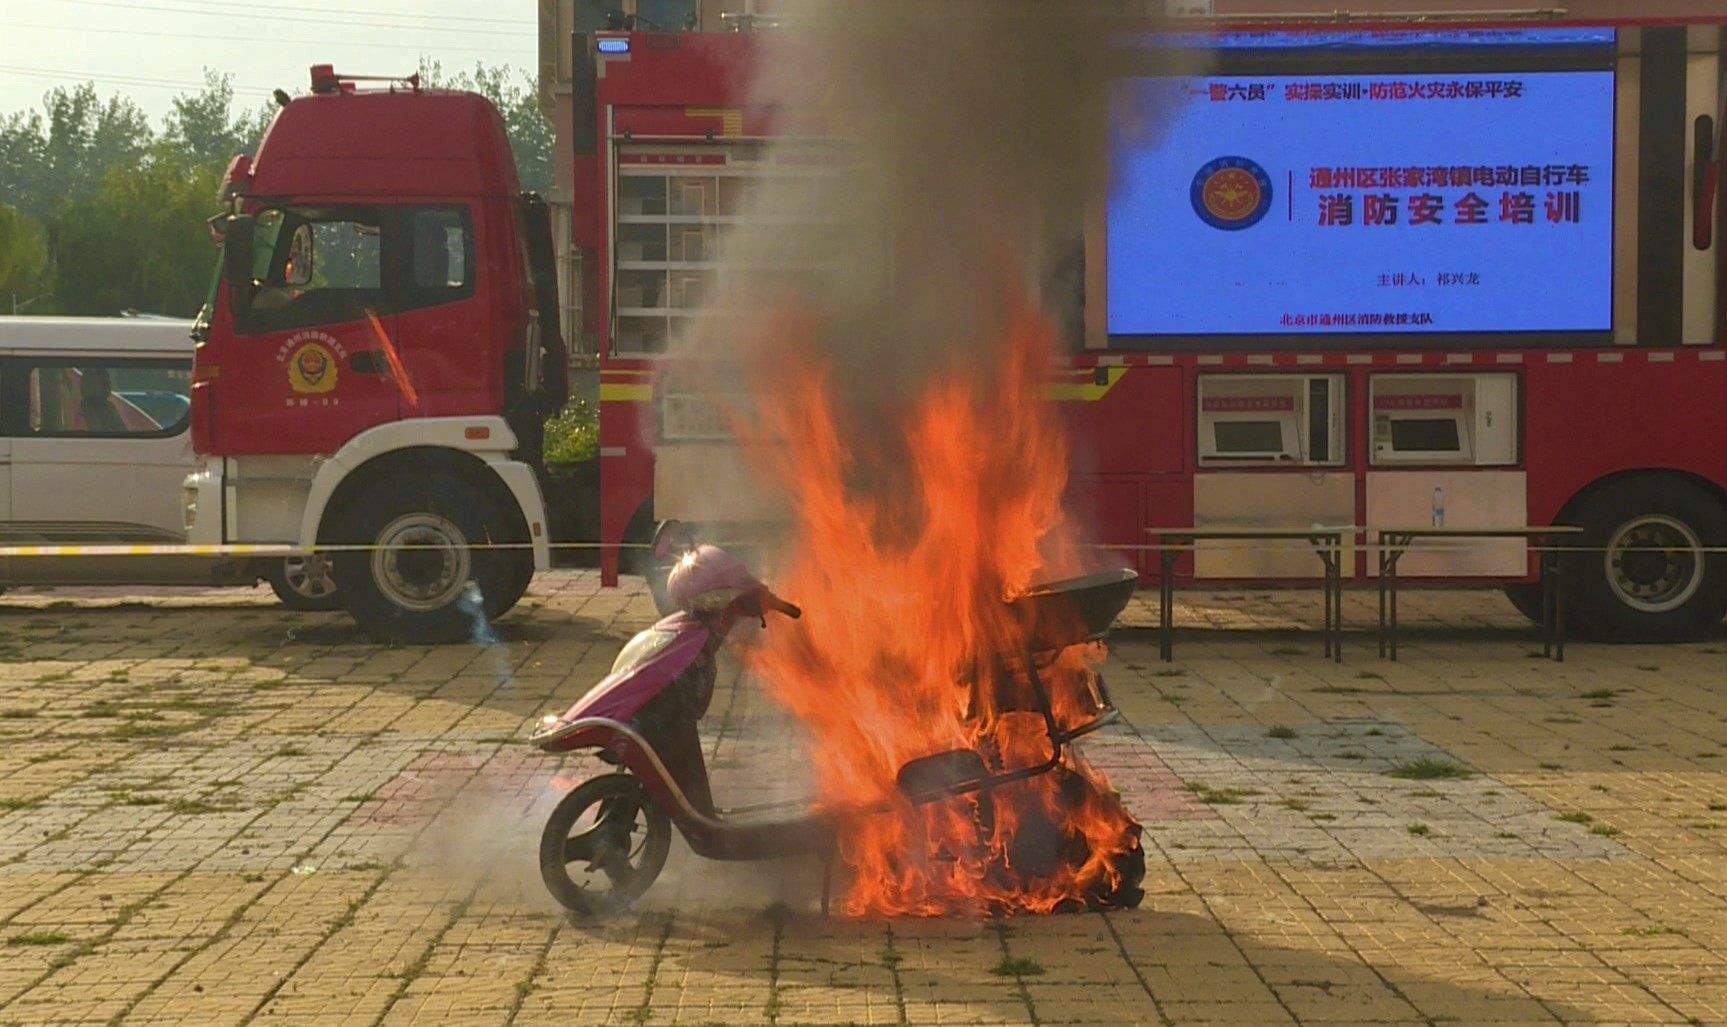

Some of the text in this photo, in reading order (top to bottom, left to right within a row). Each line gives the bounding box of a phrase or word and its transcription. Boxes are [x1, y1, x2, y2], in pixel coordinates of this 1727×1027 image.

[1310, 164, 1590, 189] 通州区张家湾镇电动自行车
[1317, 191, 1581, 226] 消防安全培训
[1280, 312, 1433, 327] 北京市通州区消防救援支队
